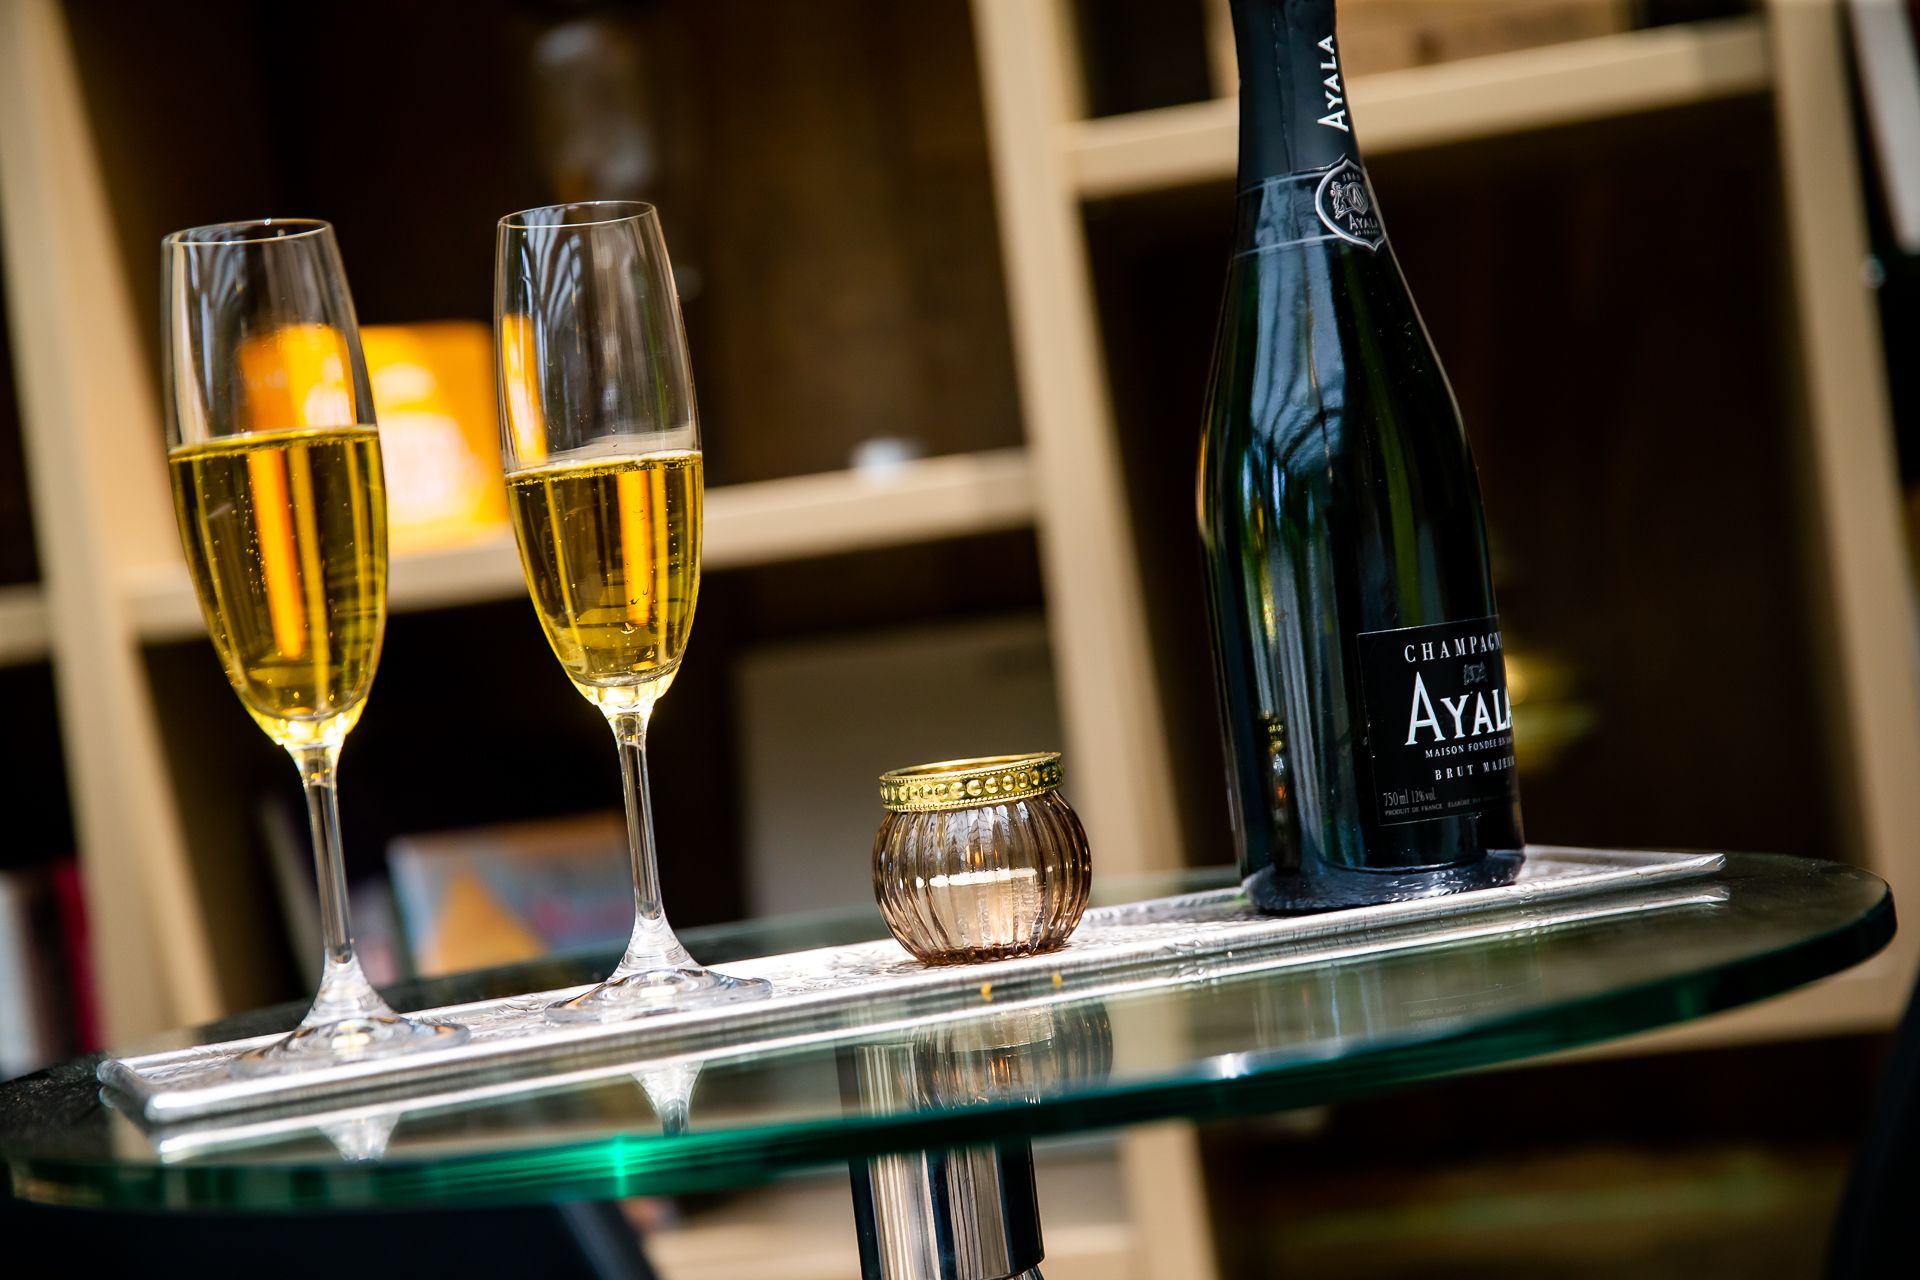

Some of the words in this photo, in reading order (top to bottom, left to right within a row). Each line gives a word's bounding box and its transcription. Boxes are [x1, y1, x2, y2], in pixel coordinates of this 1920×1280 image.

[1317, 34, 1349, 132] AYALA
[1425, 744, 1464, 758] MAISON
[1434, 764, 1474, 780] BRUT
[1383, 791, 1399, 807] 750
[1399, 788, 1409, 804] ml
[1384, 807, 1410, 816] PRODUIT
